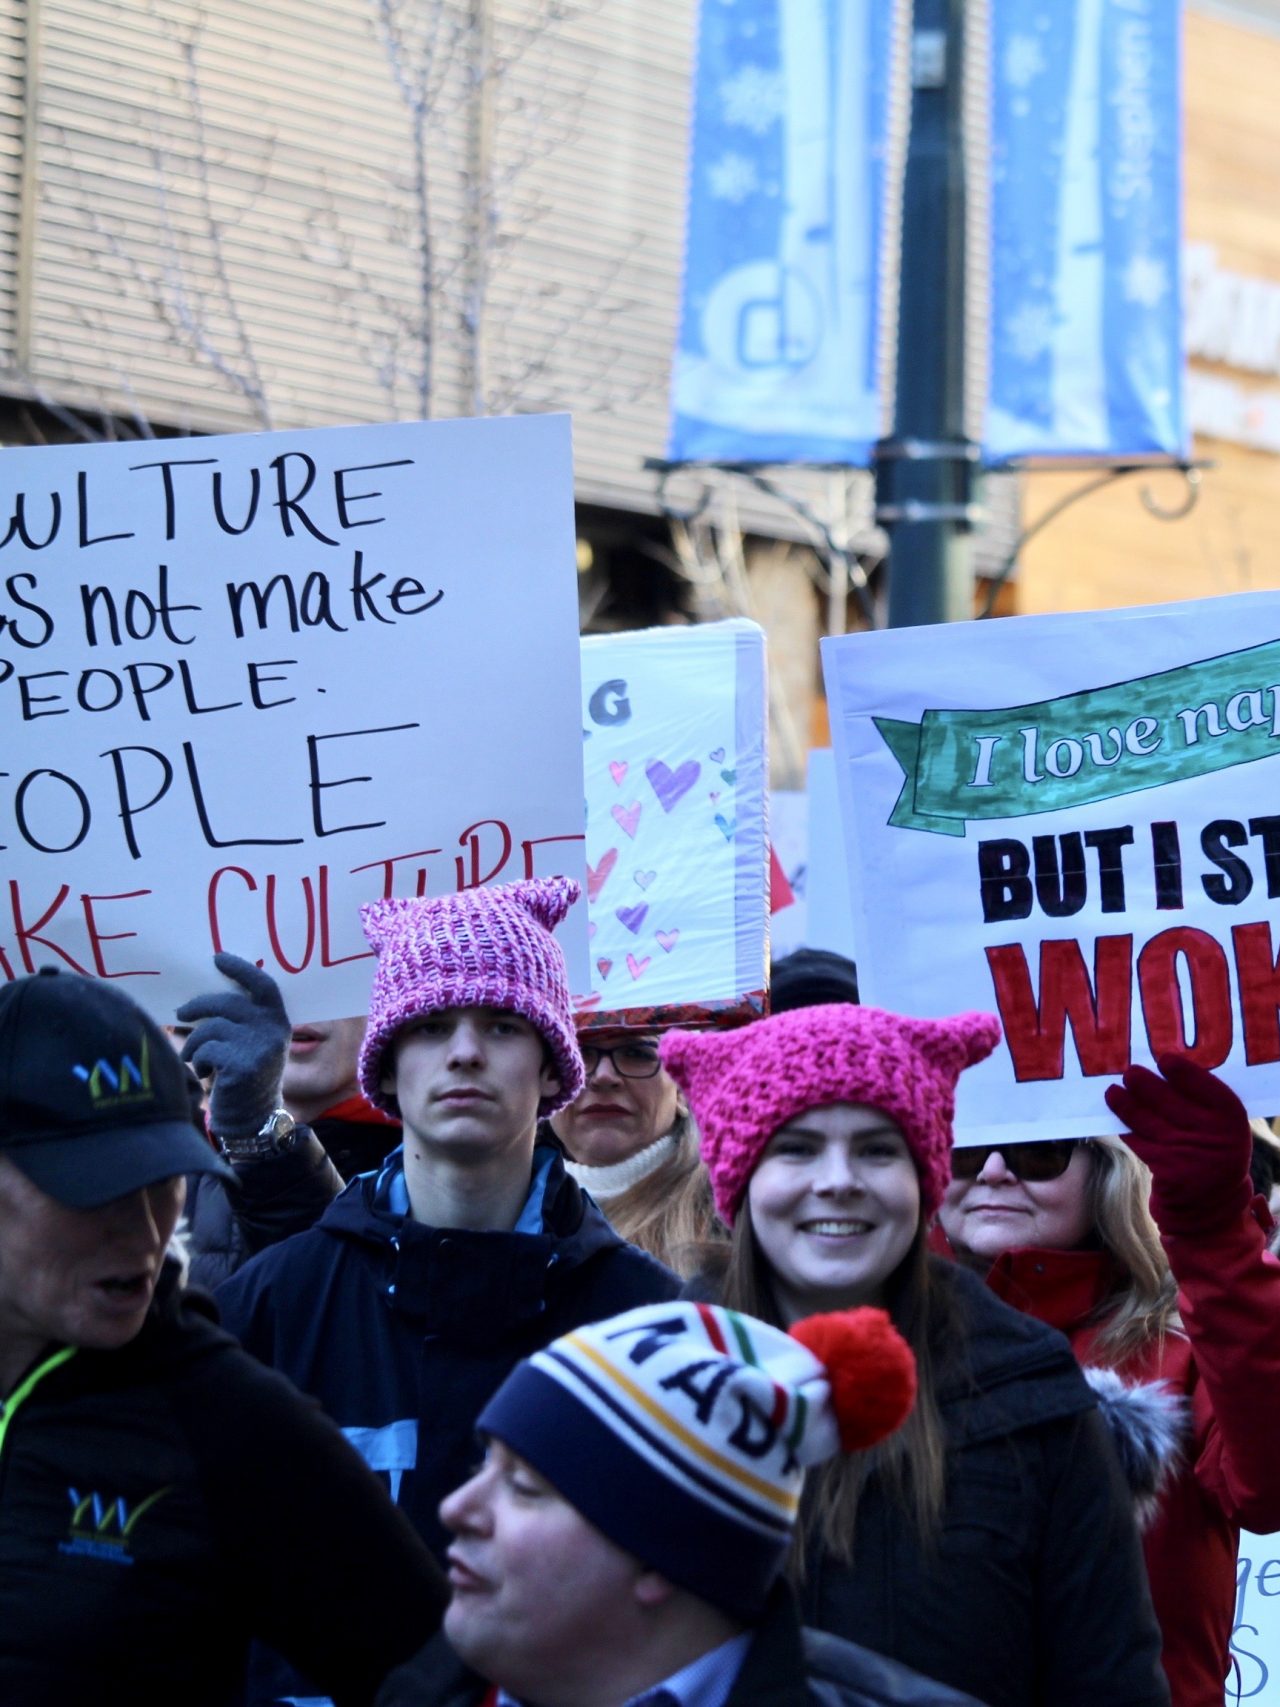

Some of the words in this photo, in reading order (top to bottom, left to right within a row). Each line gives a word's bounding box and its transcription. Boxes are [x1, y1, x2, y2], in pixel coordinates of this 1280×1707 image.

[0, 452, 415, 549] ULTURE
[80, 564, 202, 647] not
[226, 550, 444, 639] make
[0, 723, 419, 860] OPLE
[967, 736, 1001, 788] I
[1018, 724, 1162, 785] love
[978, 825, 1134, 923] BUT
[1150, 821, 1184, 911] I
